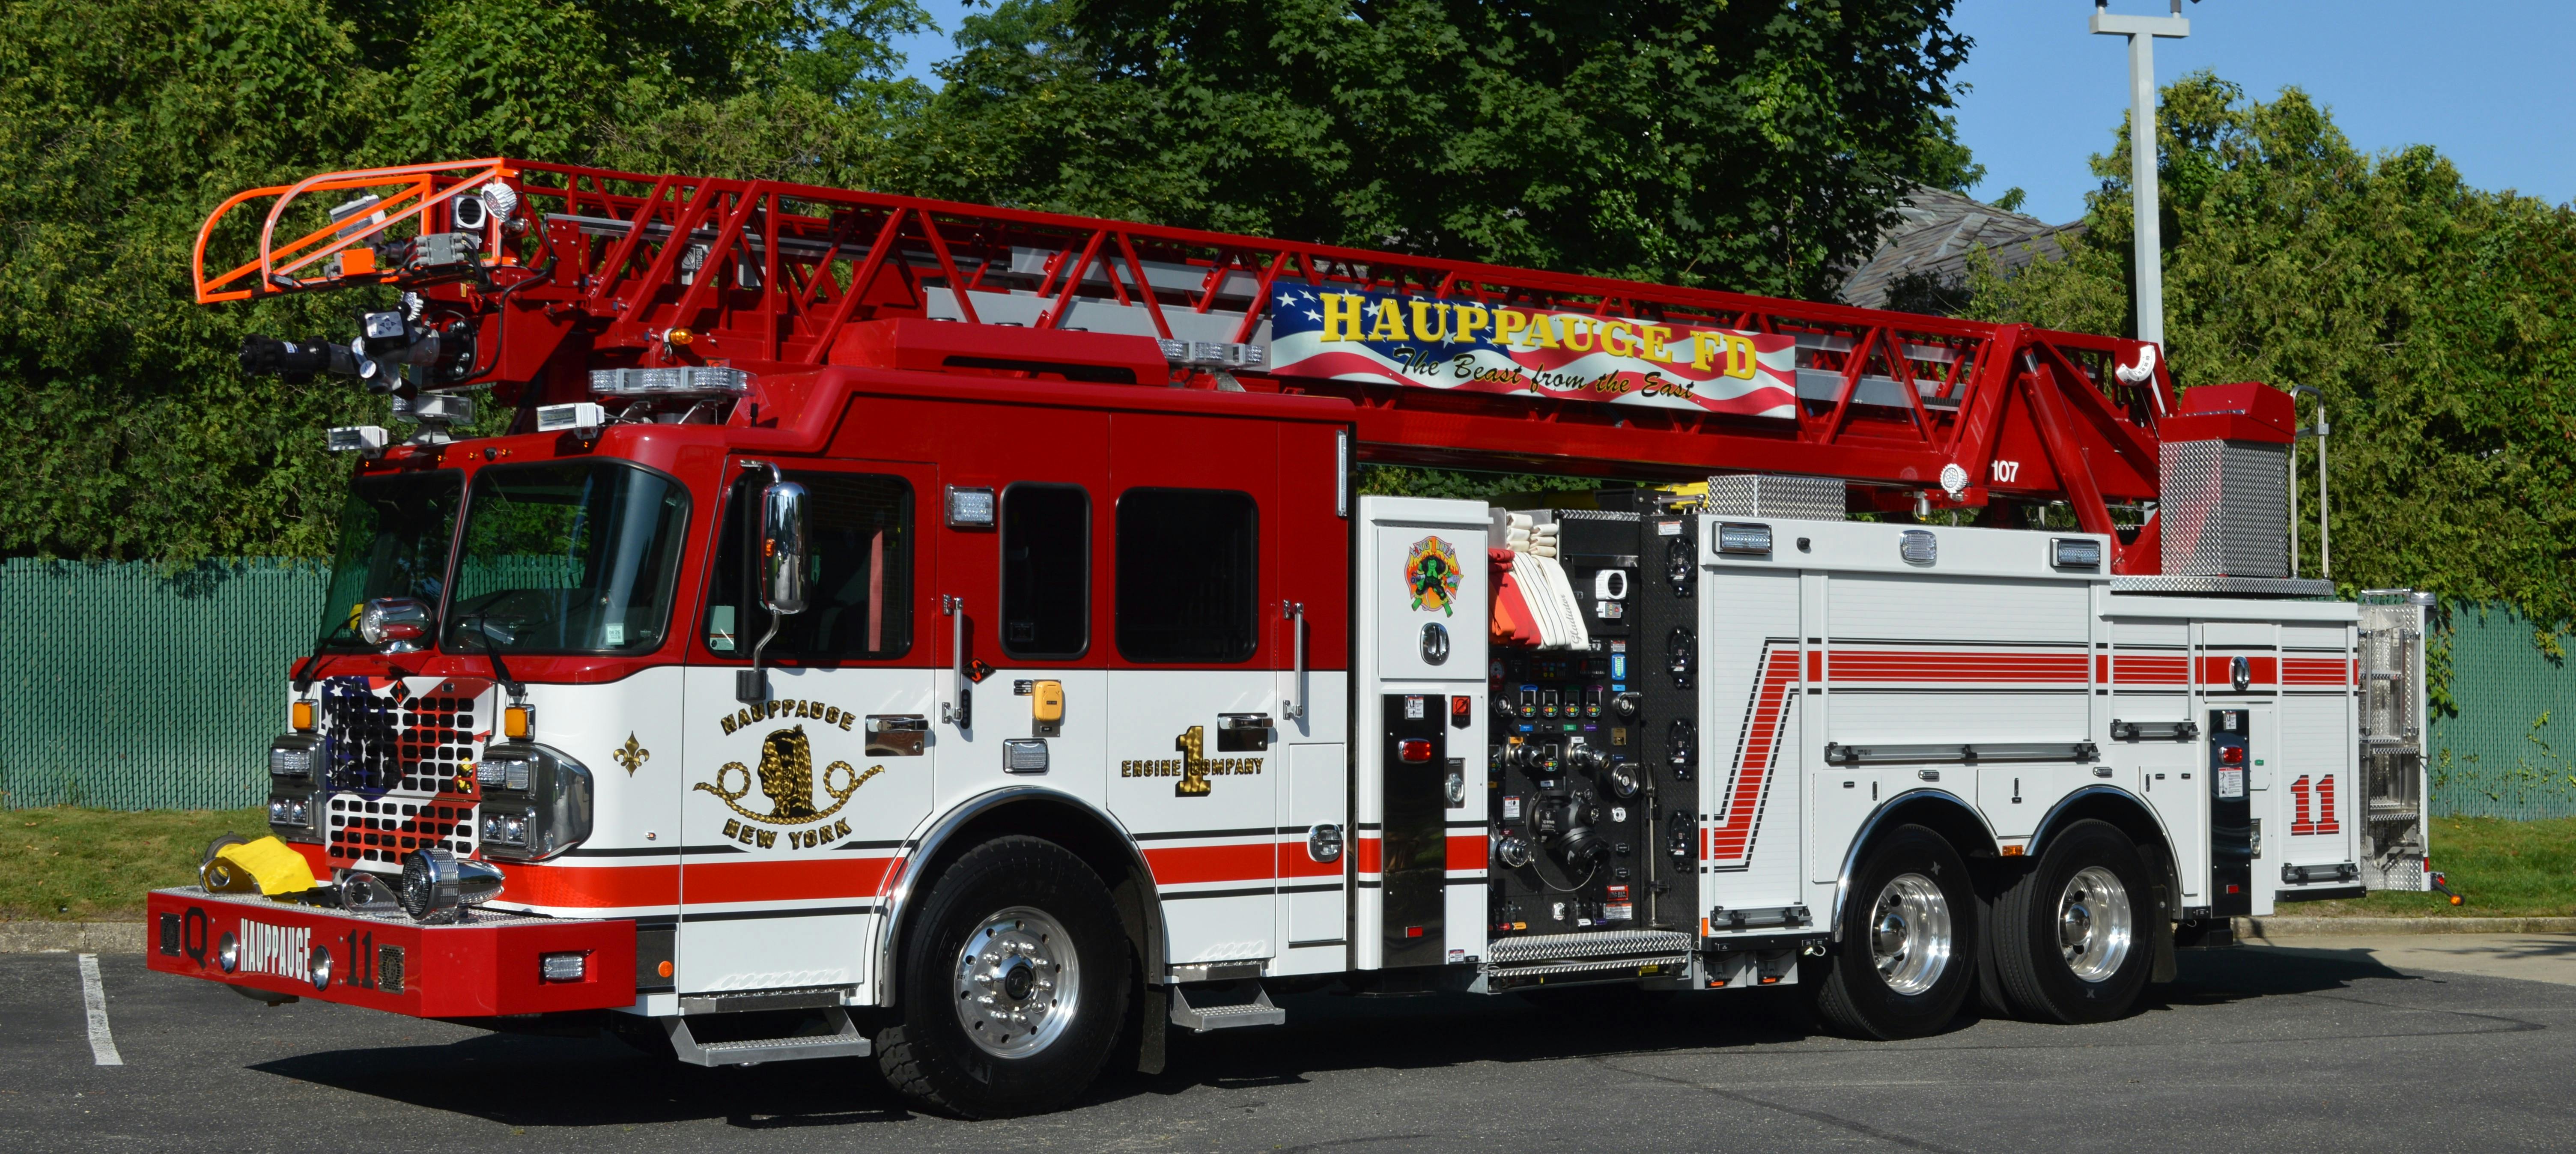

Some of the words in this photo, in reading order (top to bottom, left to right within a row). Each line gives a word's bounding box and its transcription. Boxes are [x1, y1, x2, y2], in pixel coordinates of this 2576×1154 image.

[1320, 292, 1673, 364] HAUPPAUGE
[1690, 329, 1757, 380] FD
[1392, 346, 1440, 375] The
[1453, 353, 1522, 385] Beast
[1530, 363, 1587, 394] from
[1596, 369, 1631, 394] the
[1641, 371, 1695, 400] East
[1991, 459, 2019, 483] 107
[1560, 594, 1583, 644] Gladiator
[720, 699, 856, 737] HAUPPAUGE
[1121, 759, 1182, 778] ENGINE
[1175, 725, 1211, 798] 1
[1190, 757, 1264, 776] COMPANY
[2290, 774, 2340, 836] 11
[722, 817, 778, 849] NEW
[787, 816, 853, 850] YORK
[184, 906, 207, 969] Q
[240, 918, 310, 983] HAUPPAUGE
[346, 929, 374, 989] 11
